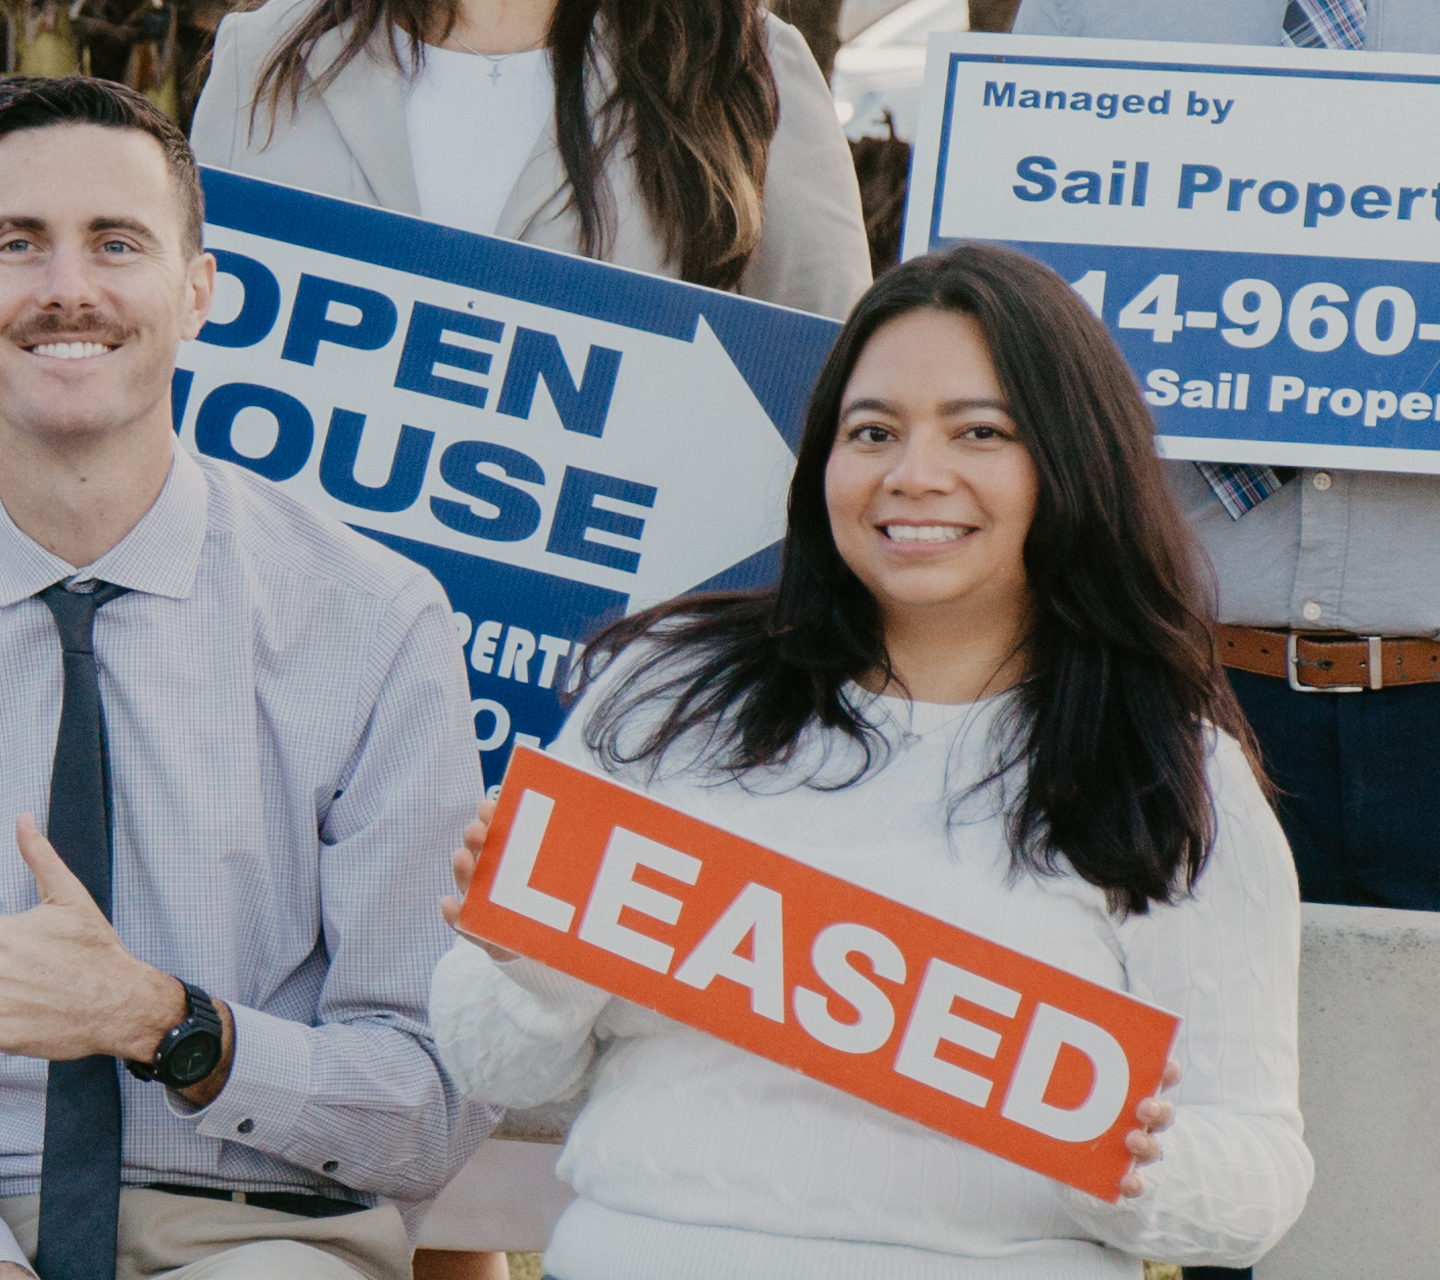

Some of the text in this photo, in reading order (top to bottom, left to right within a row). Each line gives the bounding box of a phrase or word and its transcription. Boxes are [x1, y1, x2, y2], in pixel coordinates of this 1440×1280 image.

[981, 80, 1236, 125] Managed by
[1011, 154, 1150, 209] Sail
[1144, 368, 1248, 414] Sail
[171, 368, 658, 575] OUSE
[488, 788, 1131, 1144] LEASED
